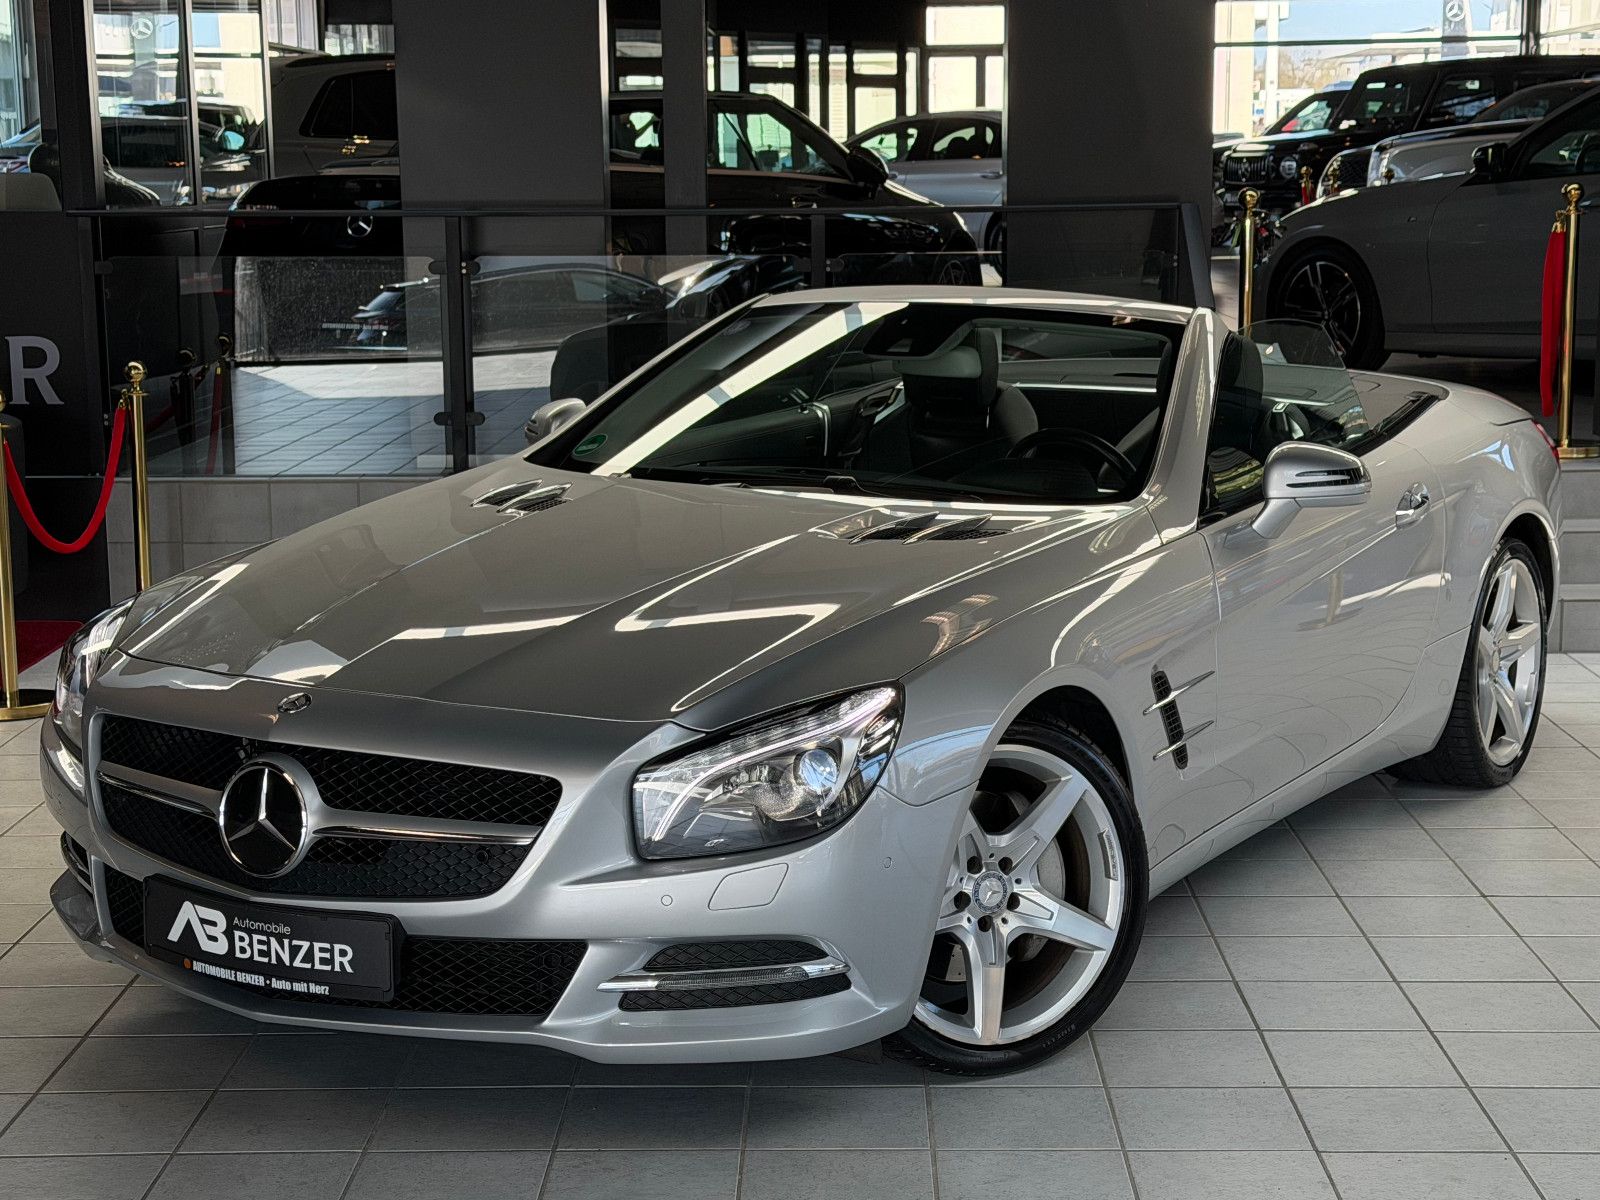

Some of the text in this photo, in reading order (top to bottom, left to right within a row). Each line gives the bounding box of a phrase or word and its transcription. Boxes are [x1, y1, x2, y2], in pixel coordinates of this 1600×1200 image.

[232, 916, 291, 935] Automobile
[233, 929, 354, 974] BENZER
[192, 960, 330, 995] AUTOMOBILE BENZER Auto mit Herz
